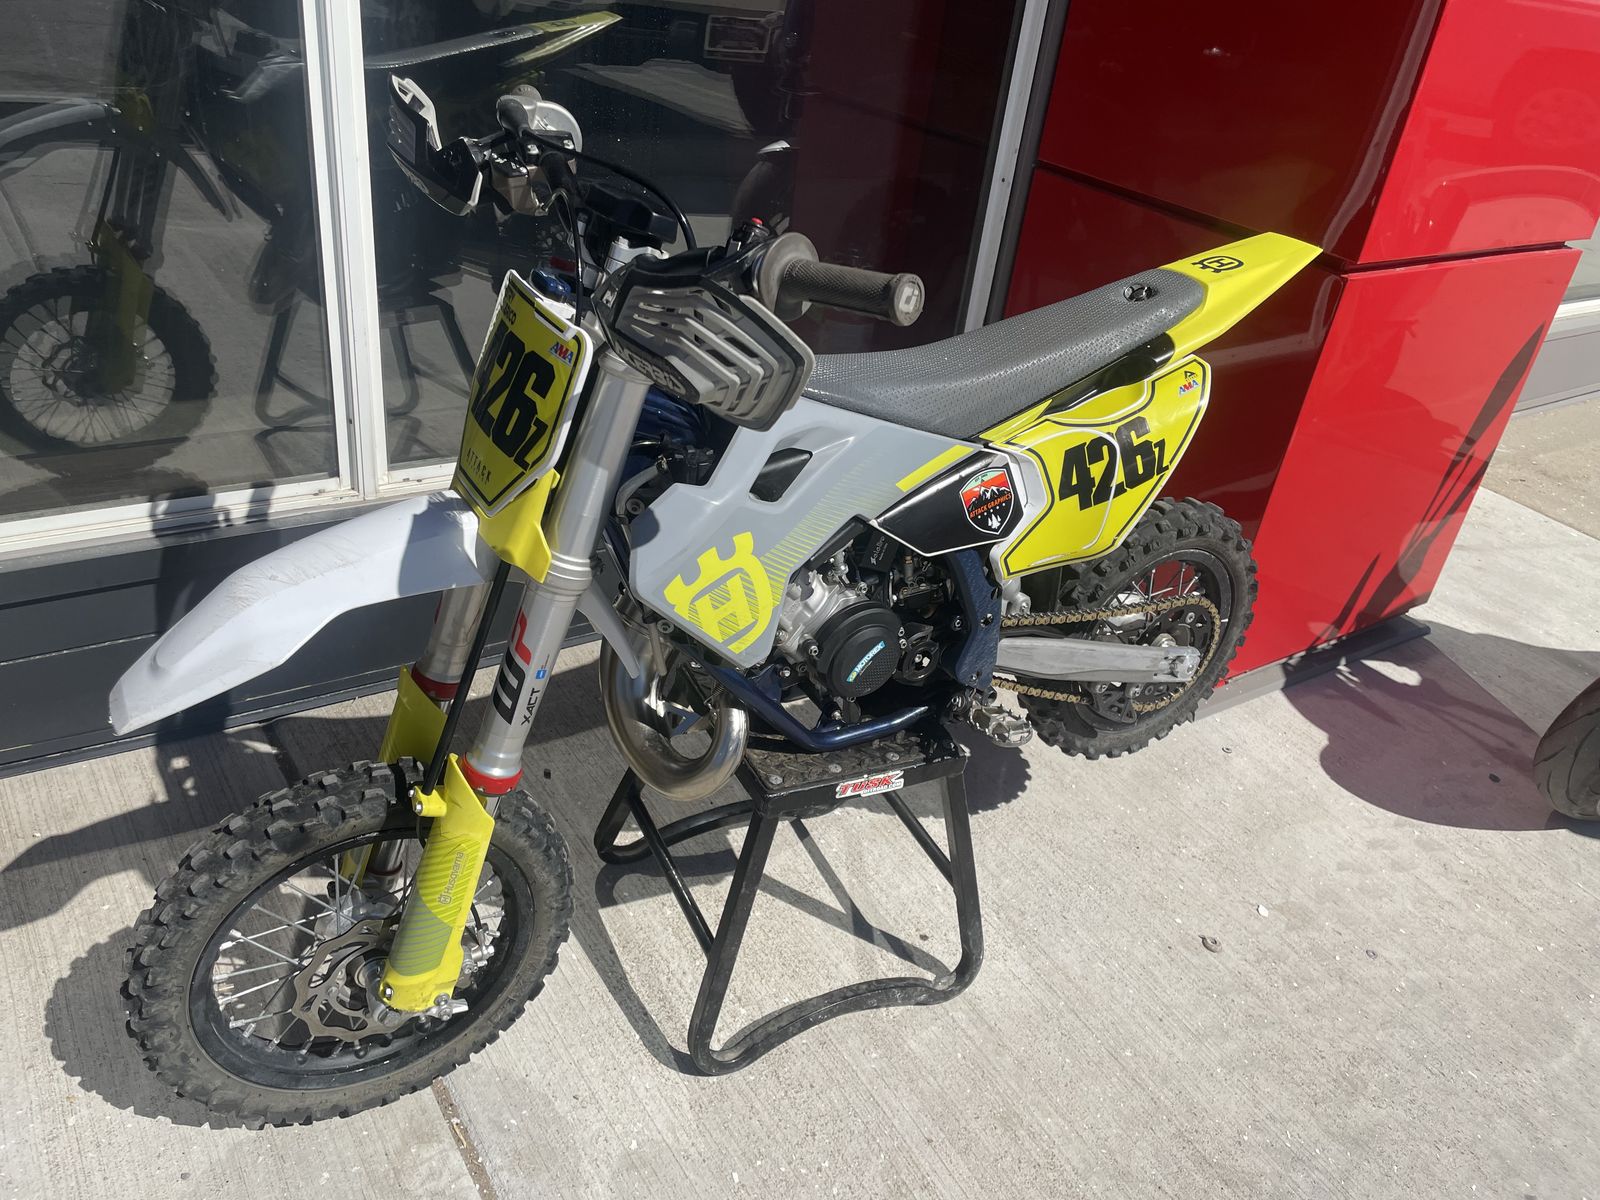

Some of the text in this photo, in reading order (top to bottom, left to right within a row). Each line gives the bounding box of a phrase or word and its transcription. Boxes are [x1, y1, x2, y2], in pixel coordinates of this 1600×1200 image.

[549, 341, 574, 365] AMA
[1179, 379, 1199, 394] AMA
[466, 447, 492, 483] ATTACK
[970, 492, 1011, 519] ATTACK GRAPHICS
[521, 687, 541, 725] XACT
[840, 774, 898, 796] TUSK
[443, 851, 464, 895] Husqvarna
